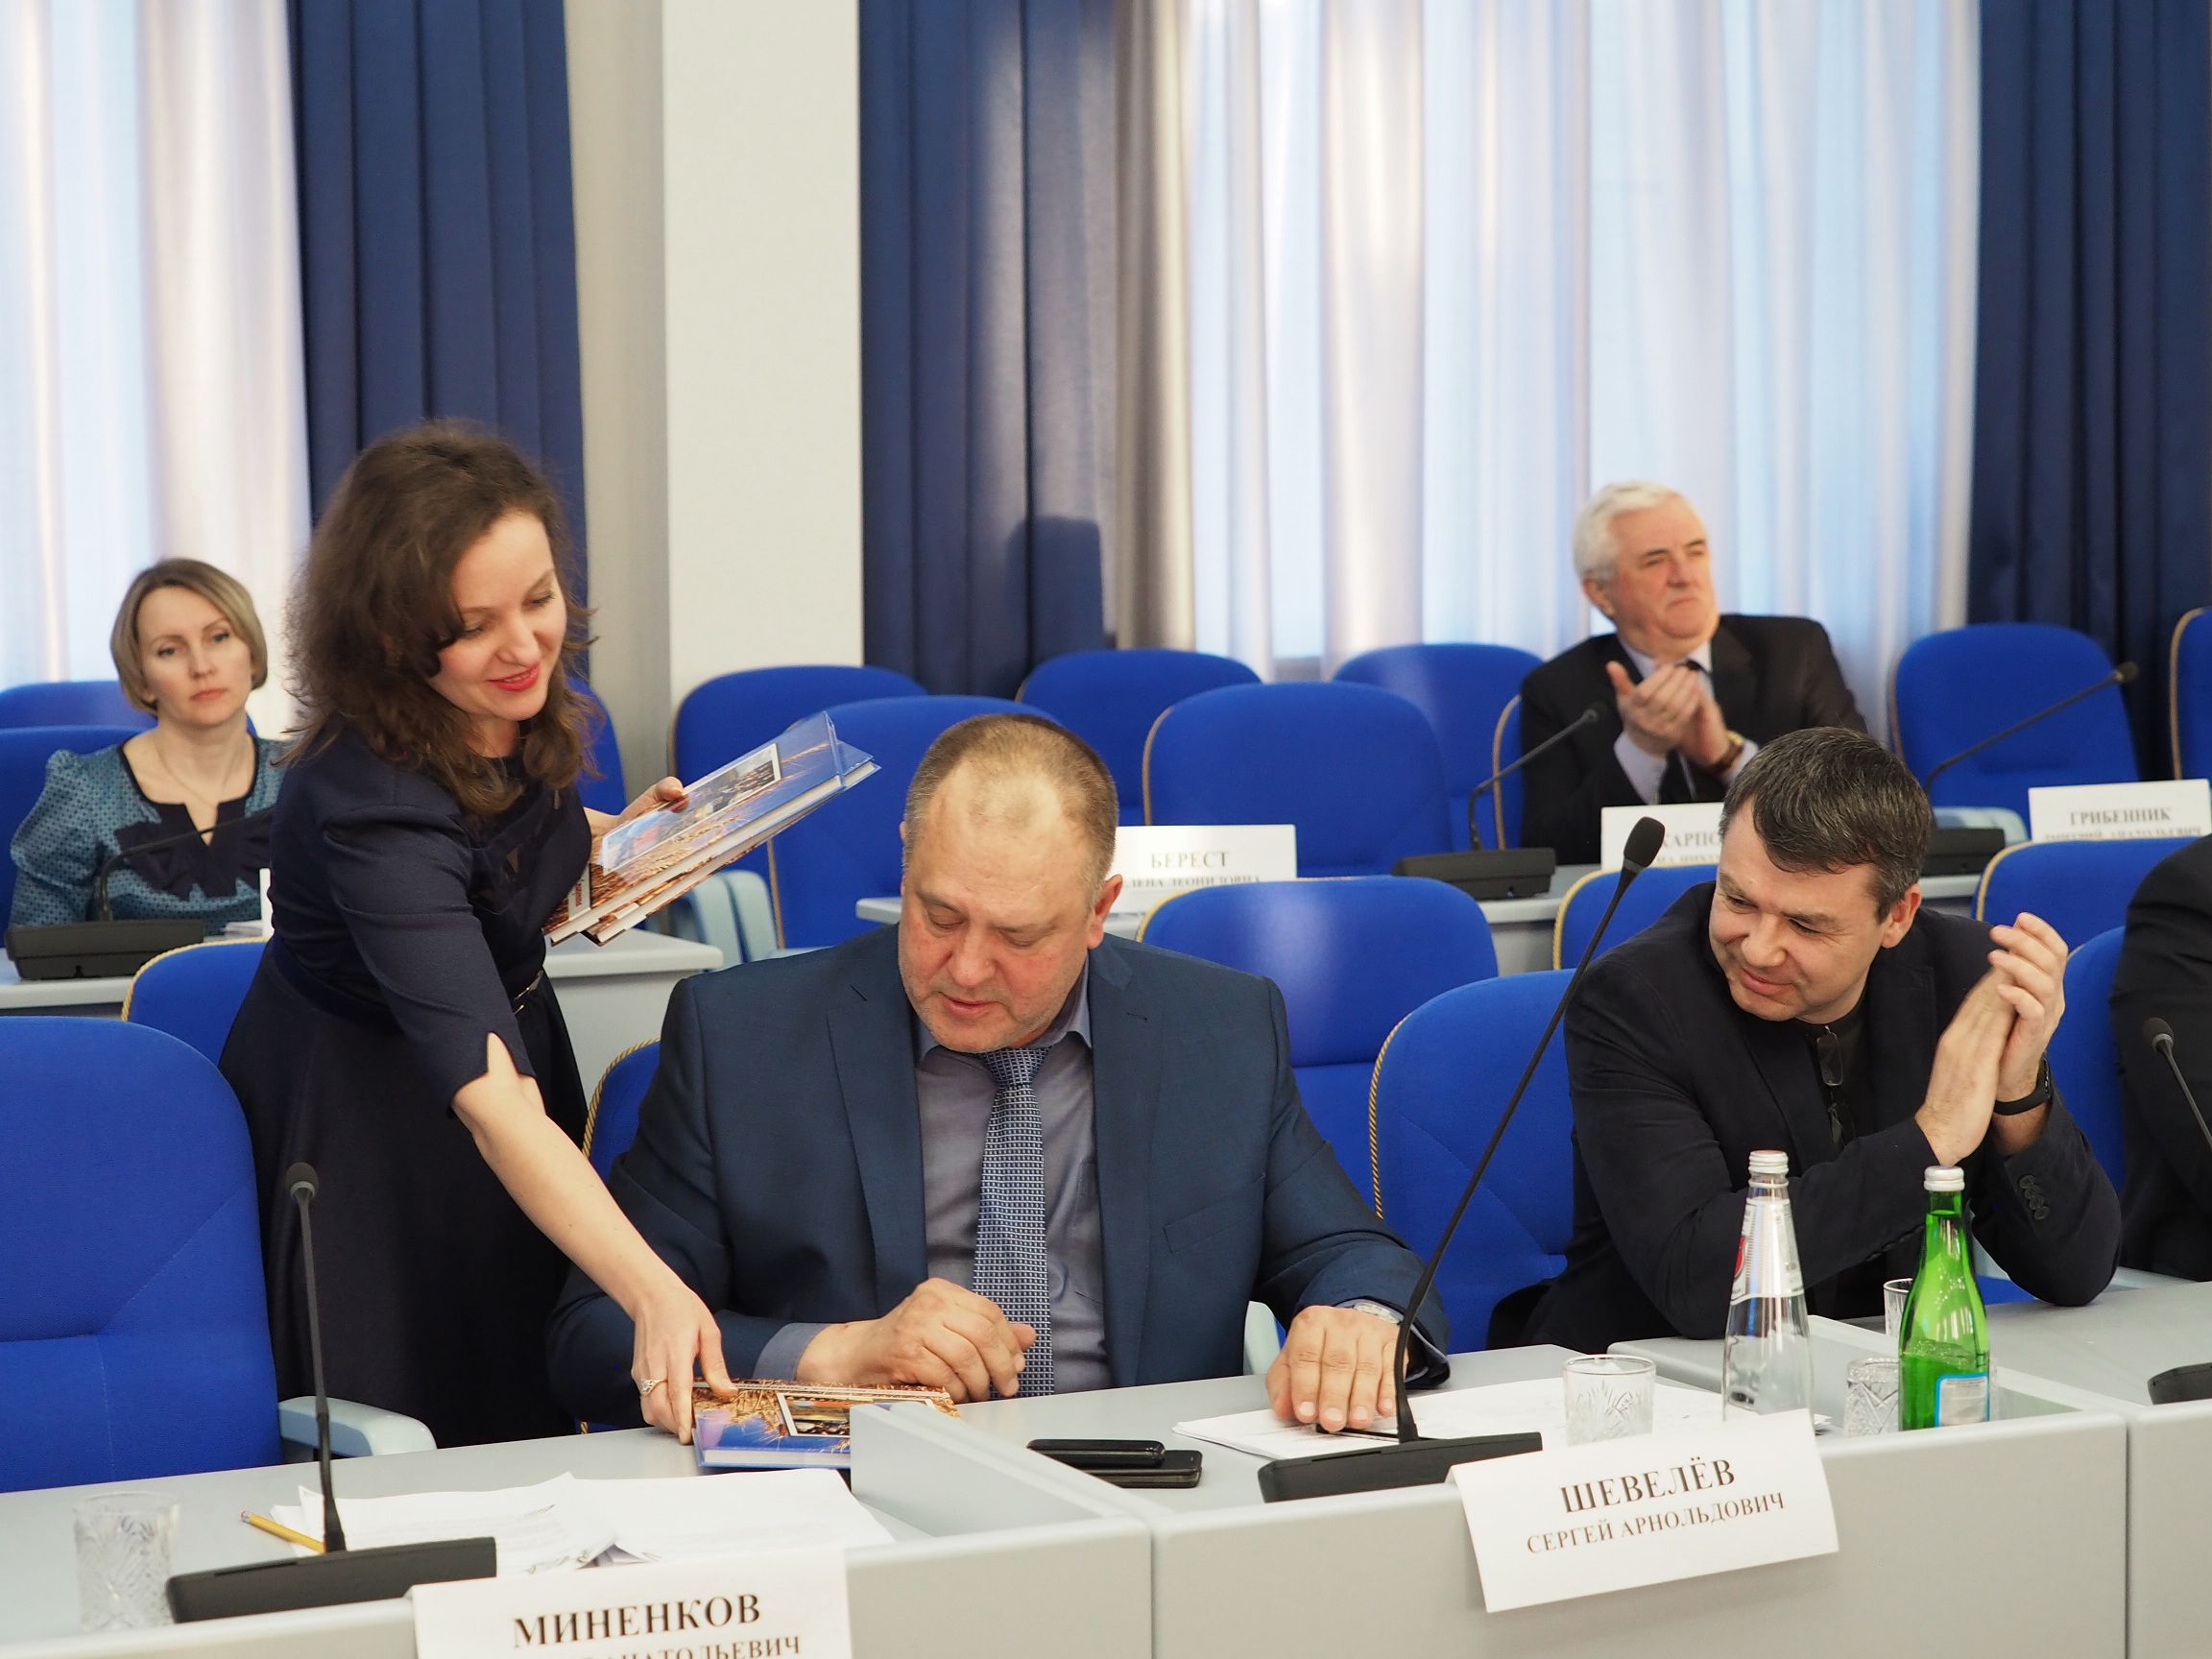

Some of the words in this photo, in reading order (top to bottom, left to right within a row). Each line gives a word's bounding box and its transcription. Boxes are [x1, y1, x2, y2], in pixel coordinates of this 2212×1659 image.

[1151, 851, 1230, 869] БЕРЕСТ
[1559, 1456, 1736, 1514] ШЕВЕЛЁВ
[1527, 1518, 1614, 1554] СЕРГЕЙ
[1621, 1491, 1786, 1539] АРНОЛЬДОВИЧ
[513, 1594, 761, 1647] МИНЕНКОВ
